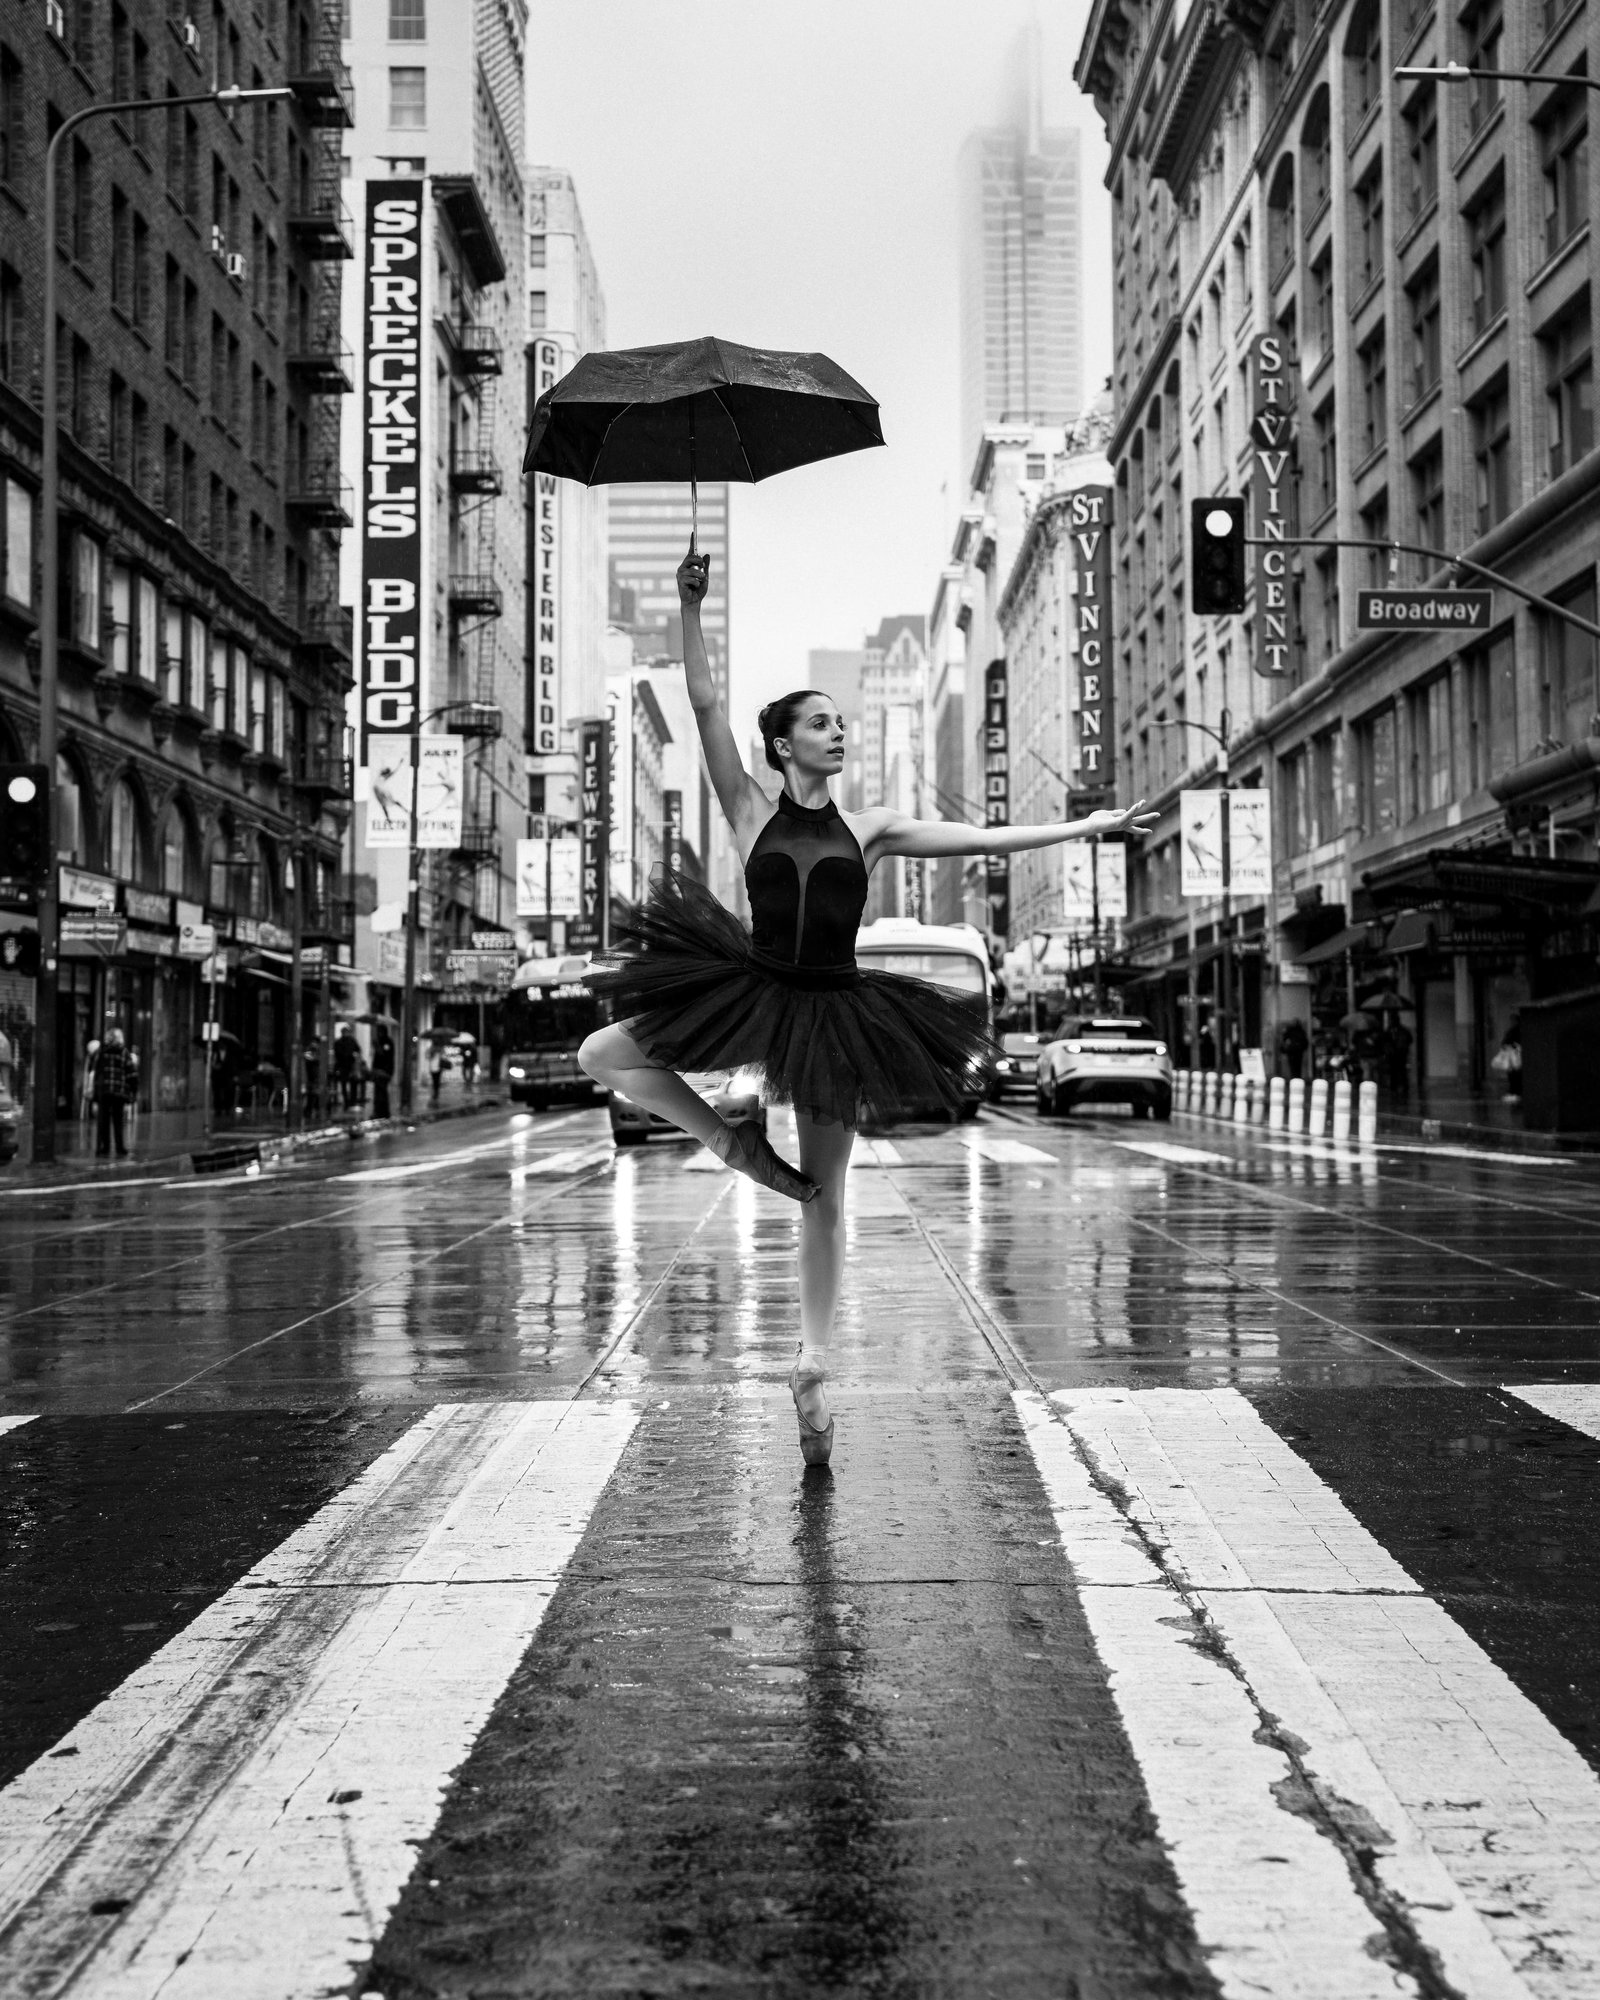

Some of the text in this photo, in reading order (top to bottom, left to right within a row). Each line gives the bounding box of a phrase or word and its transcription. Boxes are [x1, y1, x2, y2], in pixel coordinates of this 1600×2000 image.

[366, 200, 418, 728] SPRECKELS BLDG
[1072, 493, 1104, 526] ST
[1256, 450, 1290, 671] VINCENT
[539, 475, 557, 749] WESTERN BLDG
[1077, 530, 1102, 771] VINCENT
[1369, 599, 1480, 624] Broadway
[582, 740, 600, 916] JEWELRY
